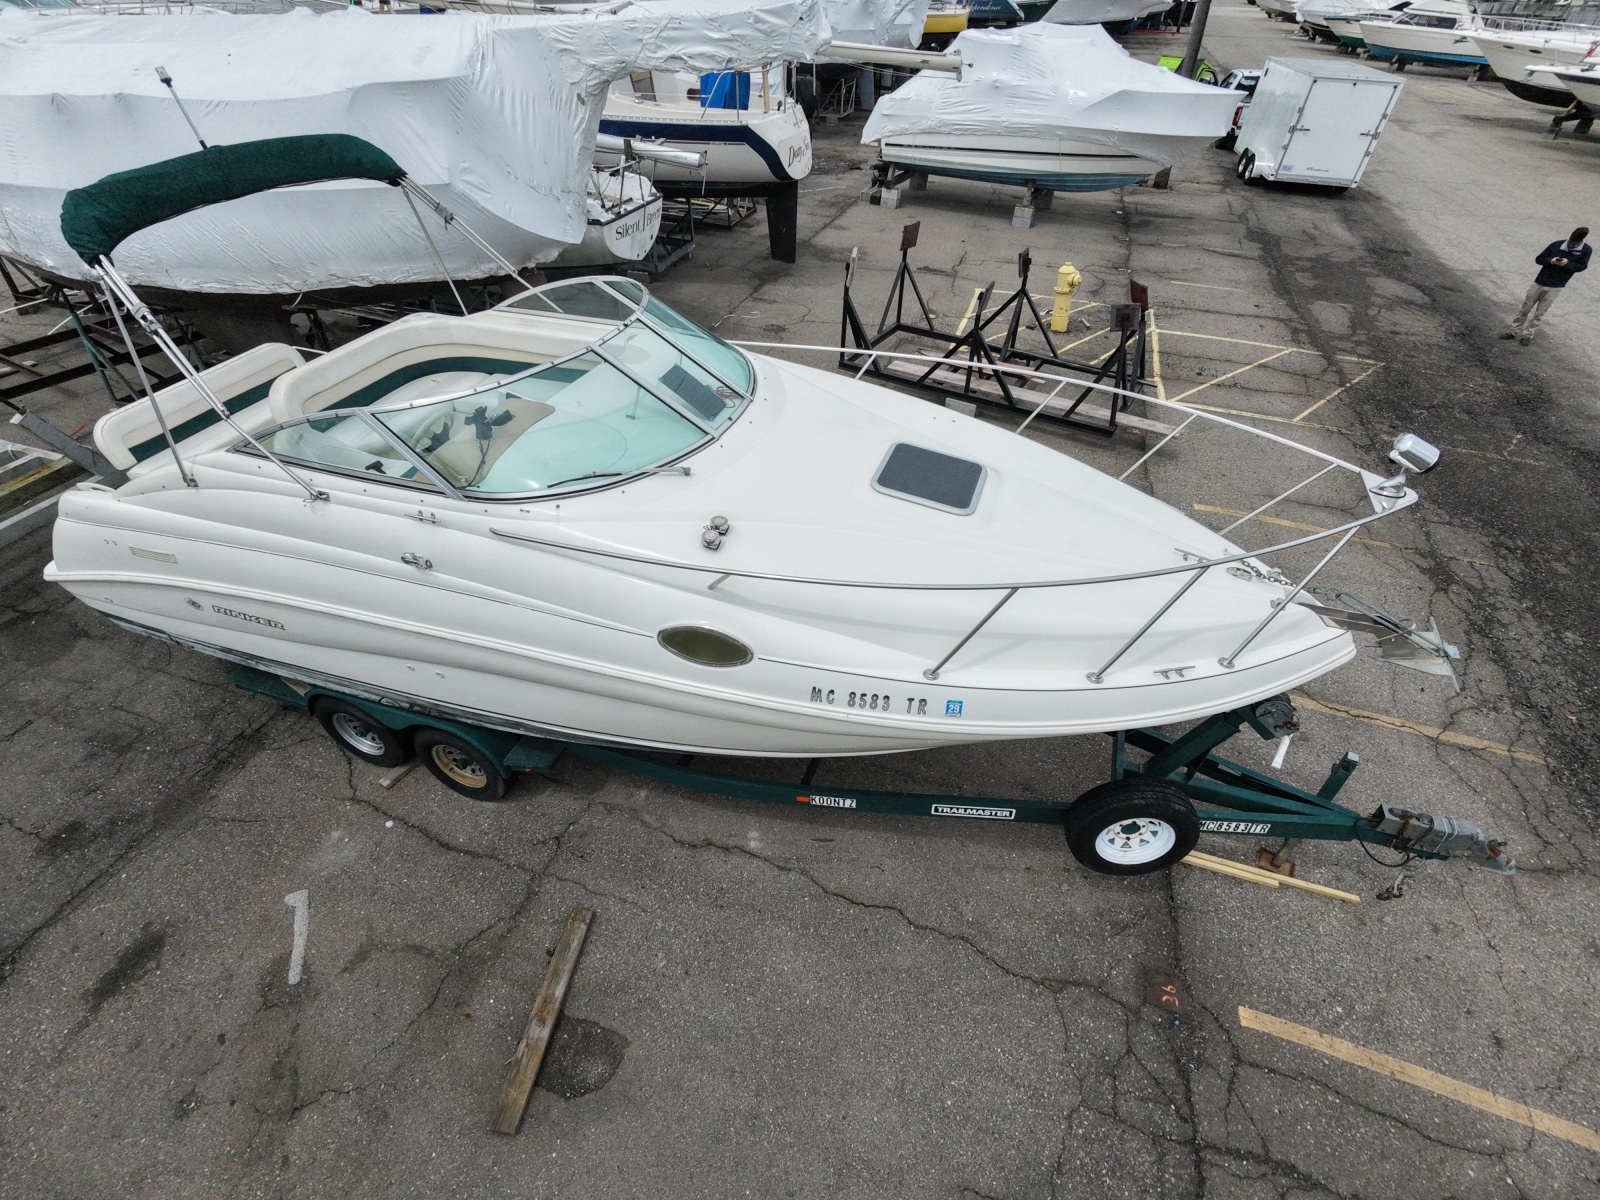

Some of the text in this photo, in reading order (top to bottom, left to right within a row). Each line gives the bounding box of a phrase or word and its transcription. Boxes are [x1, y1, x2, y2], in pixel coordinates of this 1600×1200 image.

[615, 219, 641, 241] Silent
[211, 604, 287, 631] RINKER
[810, 686, 928, 715] MC 8583 TR
[811, 795, 855, 808] KOONTZ
[936, 806, 1011, 818] TRAILMASTER
[1199, 820, 1270, 834] MC 8583 TR
